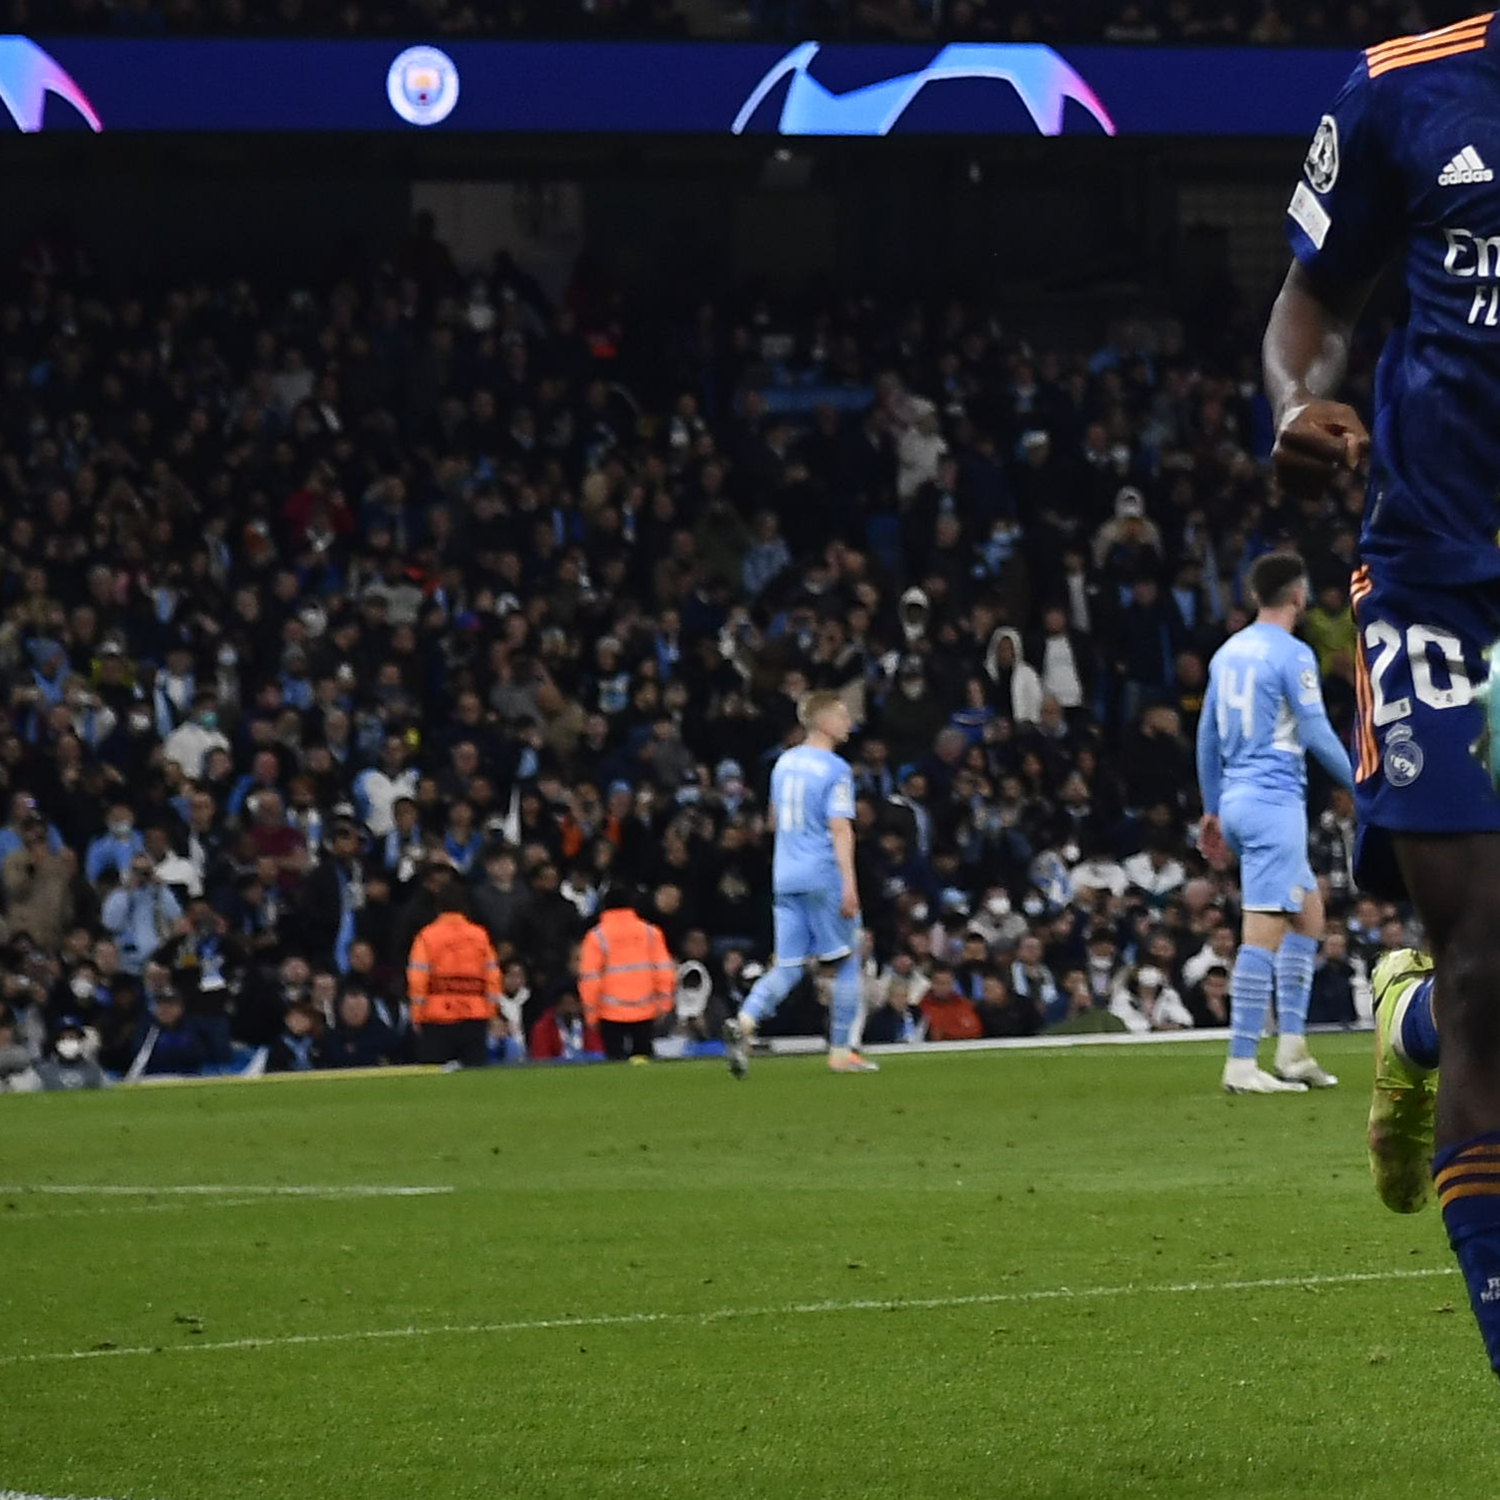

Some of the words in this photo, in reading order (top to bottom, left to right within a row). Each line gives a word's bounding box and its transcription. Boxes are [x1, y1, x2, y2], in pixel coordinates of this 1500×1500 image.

[1438, 169, 1494, 187] adidas
[1216, 666, 1255, 740] 14
[1365, 620, 1472, 727] 20
